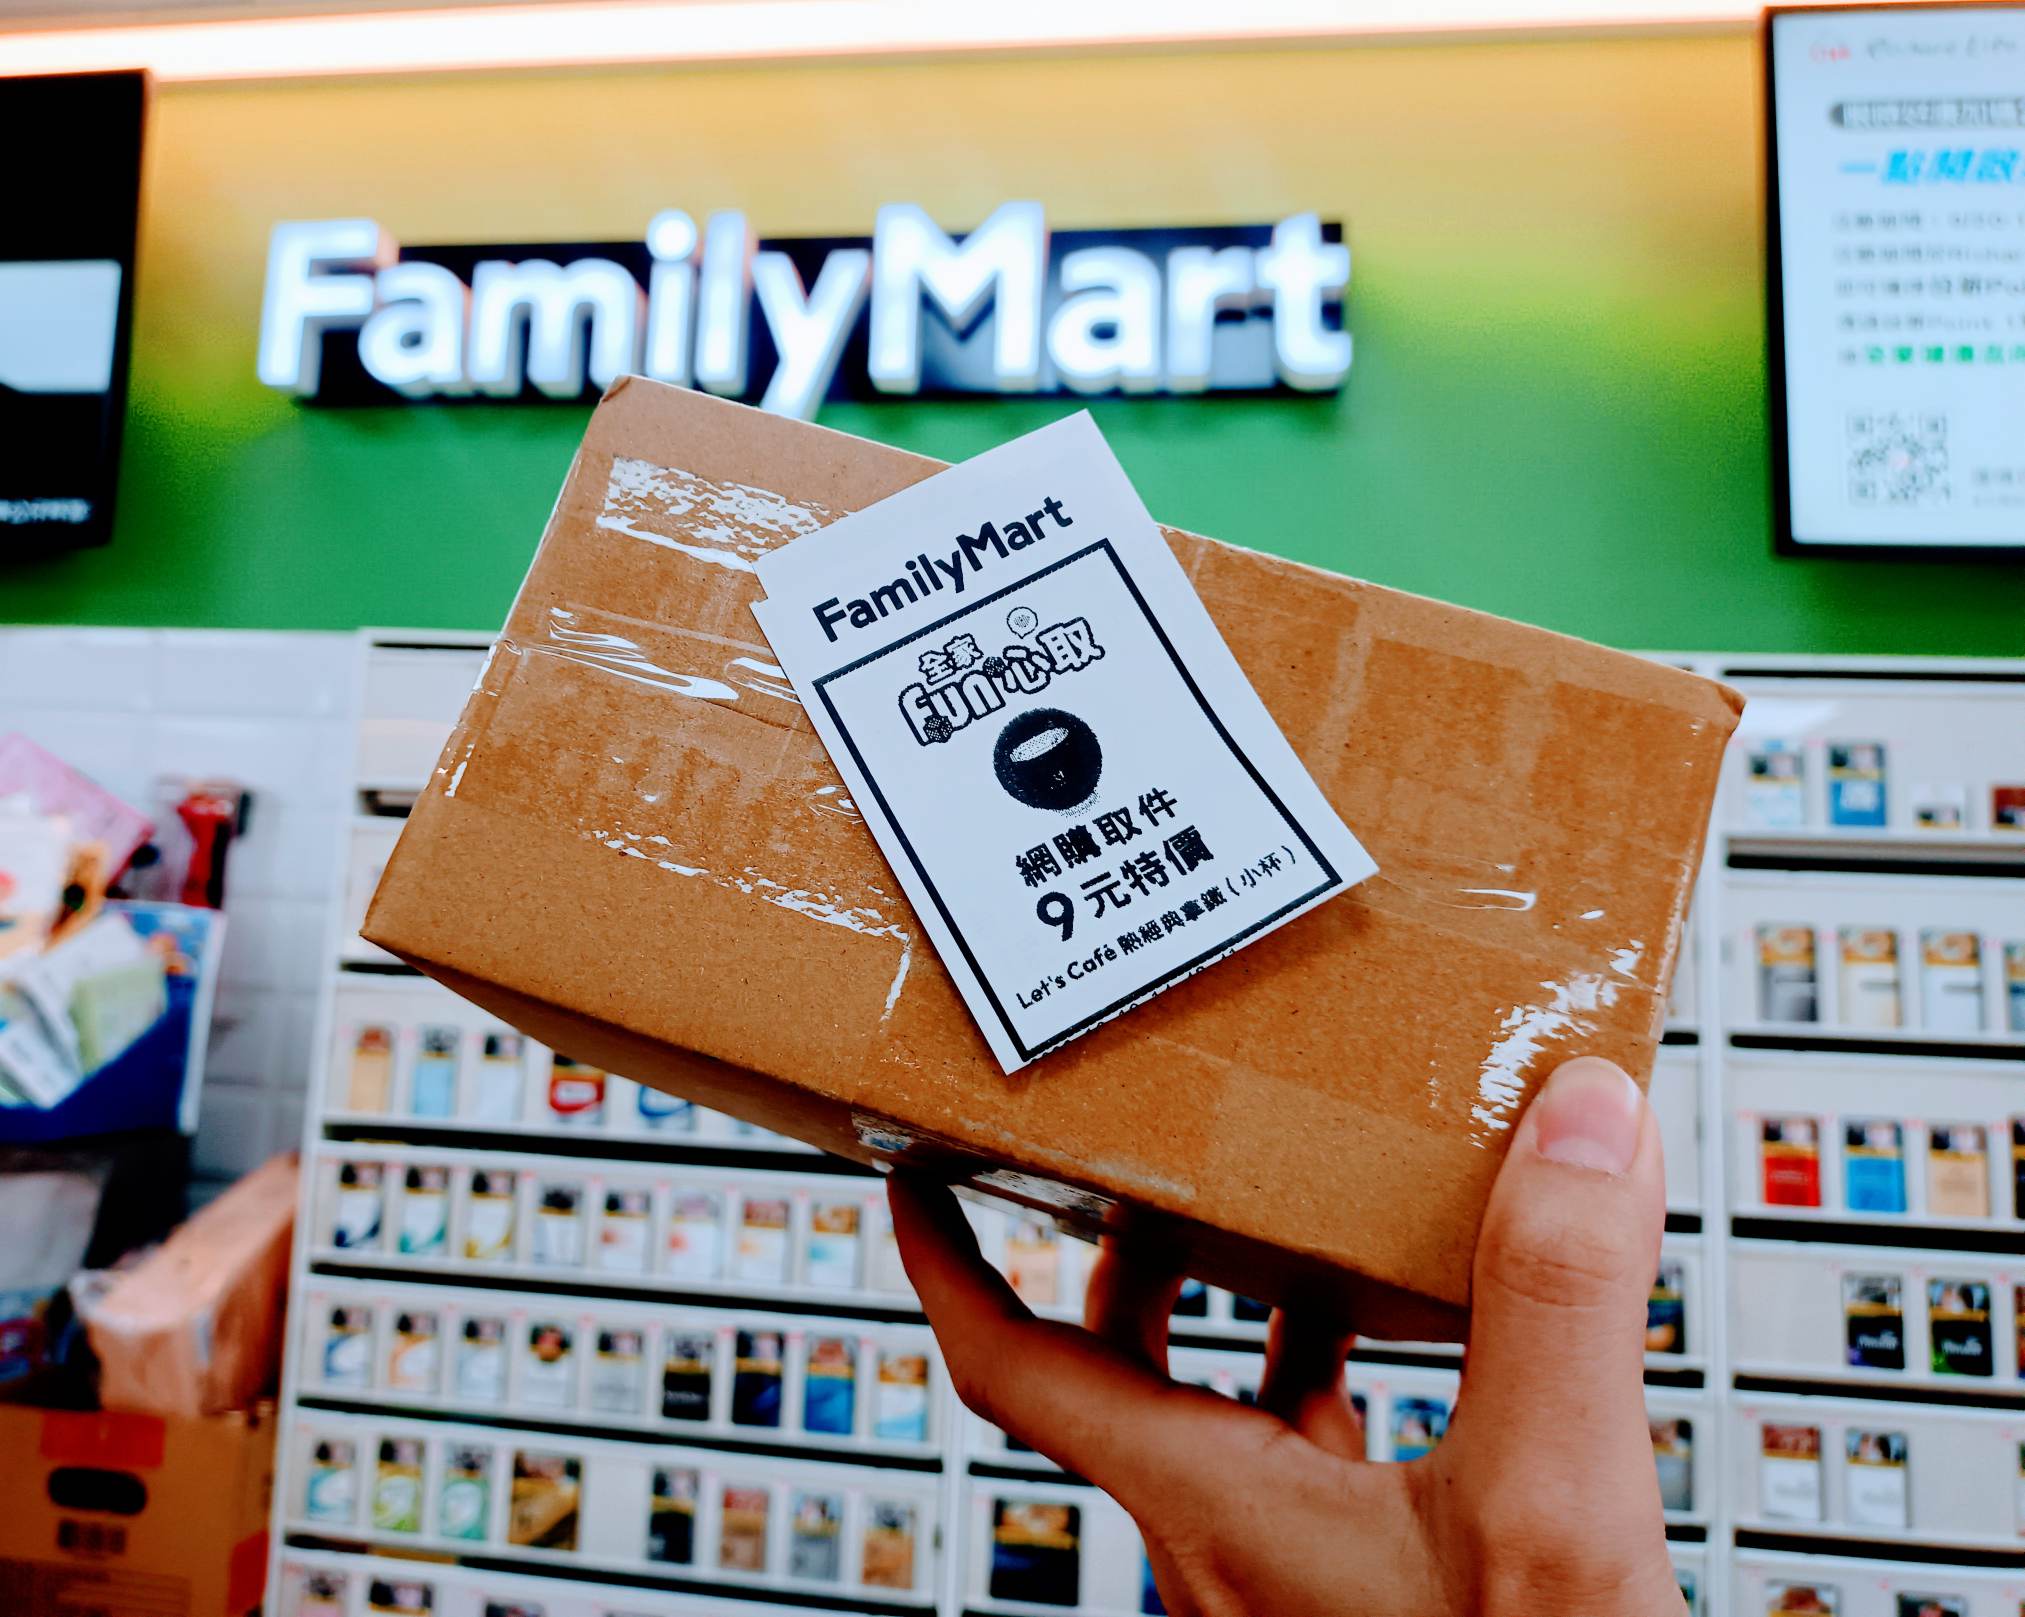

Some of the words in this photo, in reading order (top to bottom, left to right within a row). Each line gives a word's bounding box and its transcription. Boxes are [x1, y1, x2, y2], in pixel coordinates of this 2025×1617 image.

[258, 202, 1354, 420] FamilyMart
[812, 496, 1074, 643] FamilyMart
[918, 633, 984, 685] 全家
[1015, 787, 1178, 888] 網購取件
[1016, 976, 1067, 1010] Let's
[1067, 944, 1118, 981] Café
